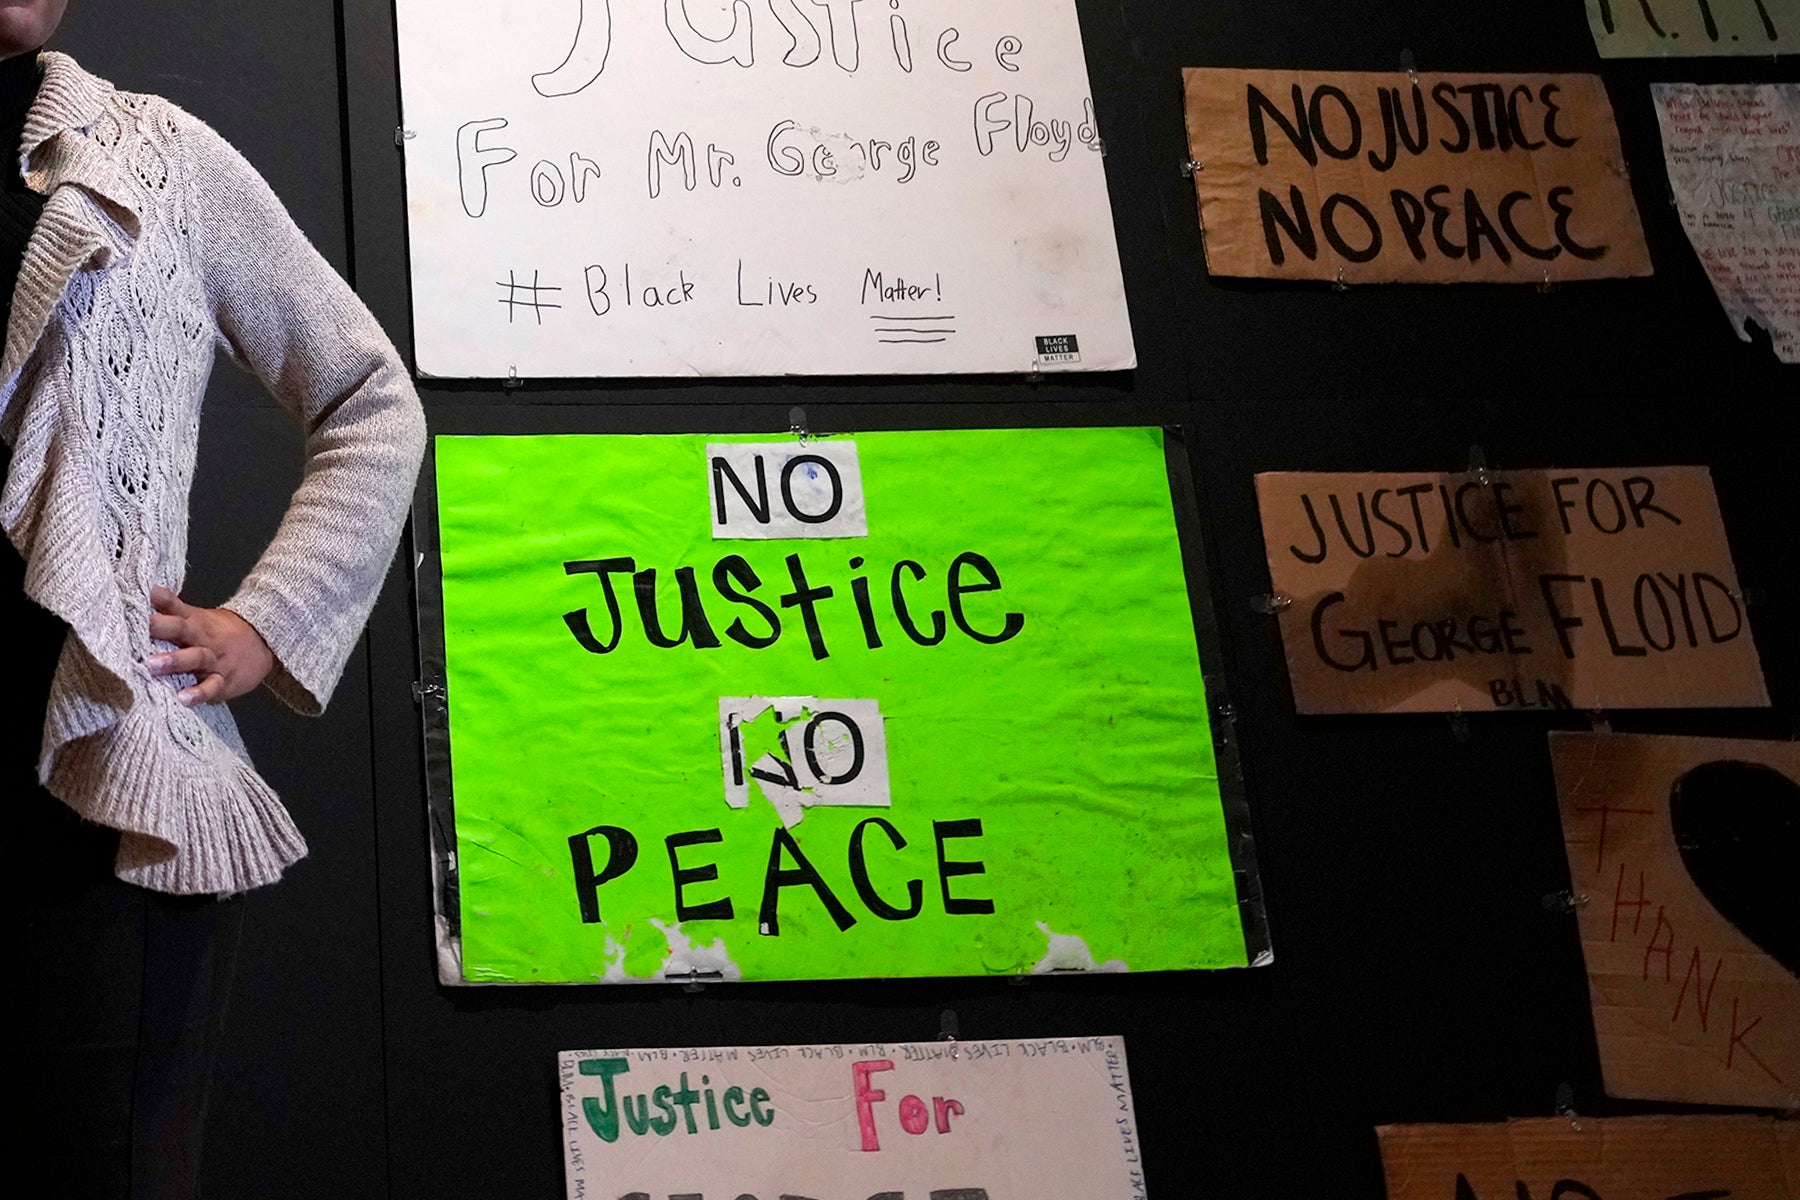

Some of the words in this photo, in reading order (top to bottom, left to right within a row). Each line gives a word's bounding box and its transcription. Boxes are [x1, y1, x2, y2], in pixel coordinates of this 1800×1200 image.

[456, 117, 602, 218] For
[648, 129, 743, 200] Mr.
[973, 91, 1100, 163] Floyd
[1247, 83, 1364, 167] NO
[1368, 83, 1580, 173] JUSTICE
[1260, 184, 1383, 267] NO
[1400, 184, 1612, 266] PEACE
[585, 264, 696, 318] Black
[736, 259, 819, 308] Lives
[860, 269, 944, 306] Matter!
[1043, 337, 1068, 346] BLACK
[1044, 353, 1074, 361] MATTER
[1045, 345, 1069, 353] LIVES
[711, 454, 845, 527] NO
[1290, 479, 1540, 568] JUSTICE
[1550, 474, 1682, 537] FOR
[562, 551, 1025, 661] Justice
[1310, 590, 1534, 672] GEORGE
[1538, 571, 1745, 660] FLOYD
[1488, 676, 1572, 711] BLM
[726, 710, 865, 792] NO
[567, 816, 997, 938] PEACE
[1574, 805, 1786, 1084] THANK
[578, 1057, 775, 1144] Justice
[851, 1059, 966, 1152] For
